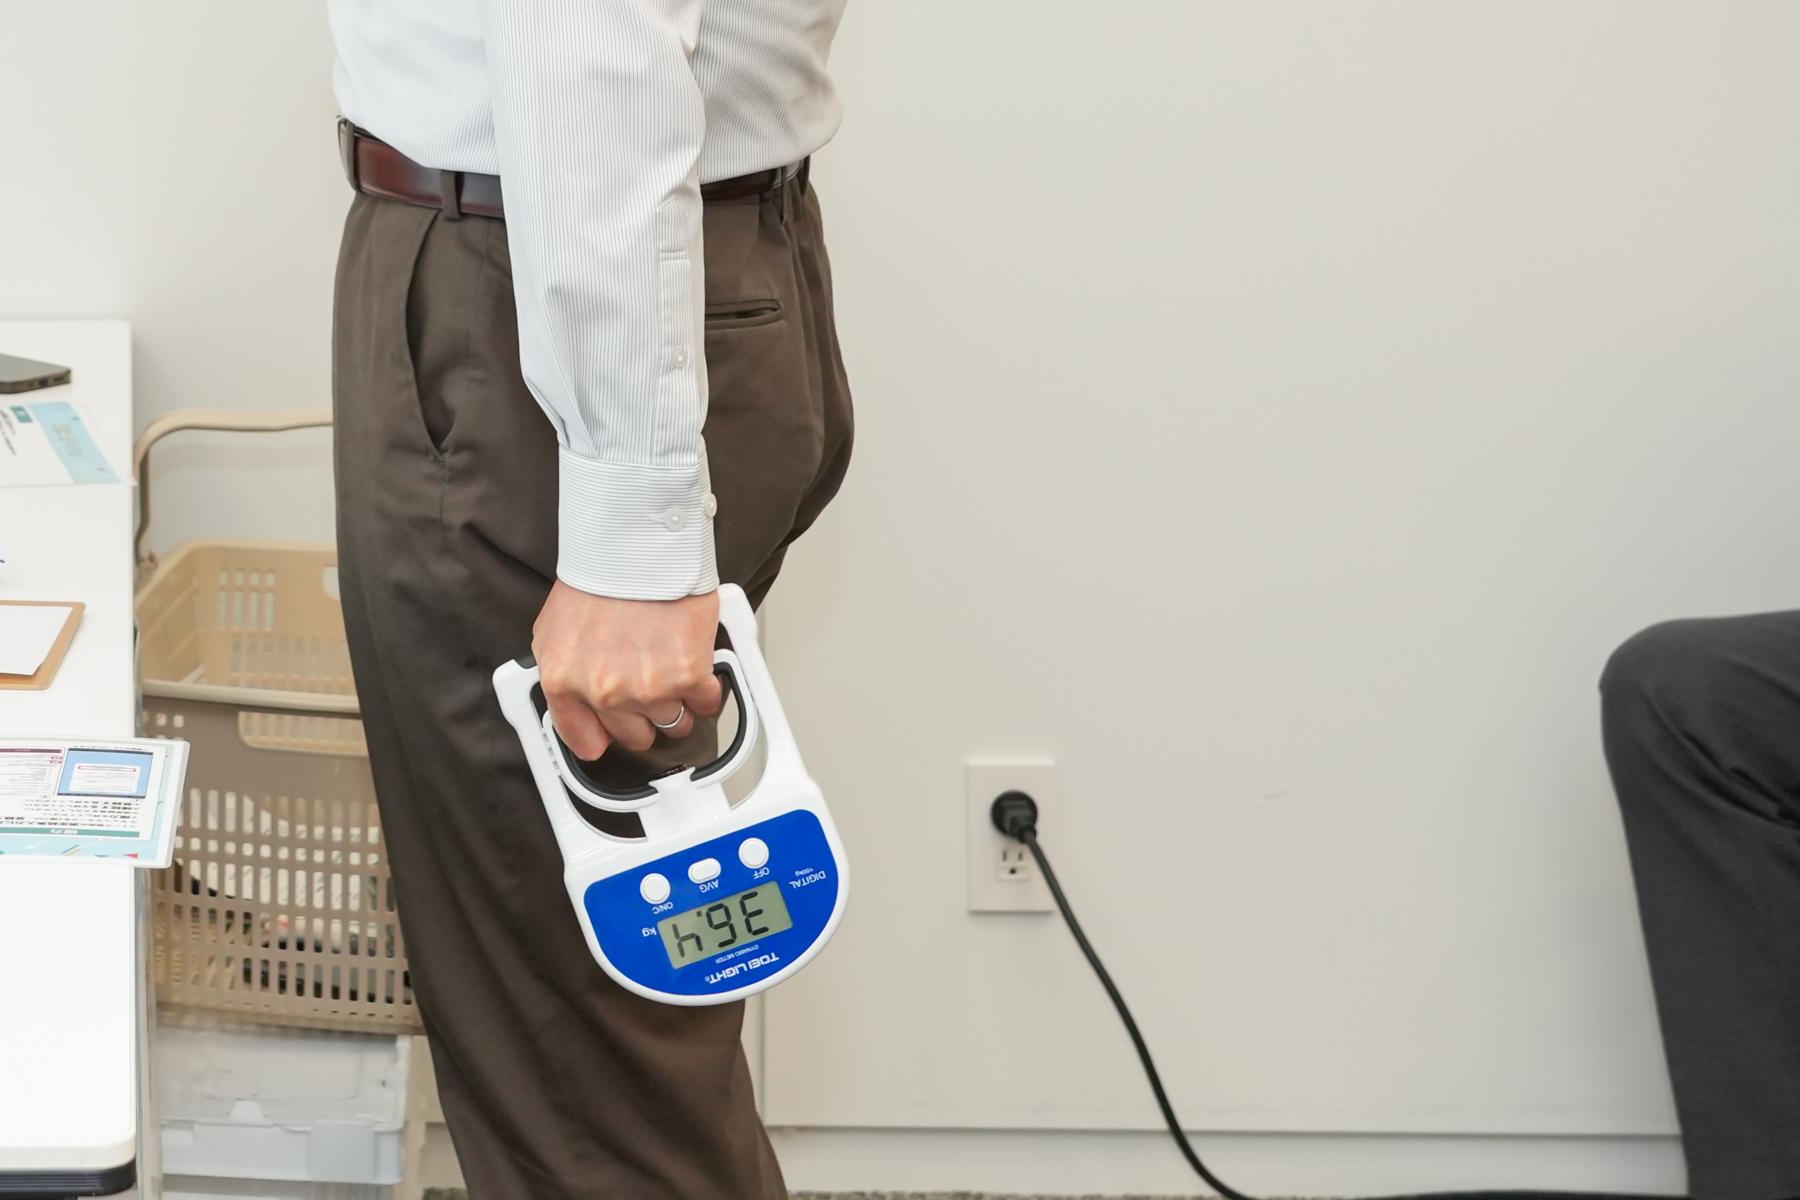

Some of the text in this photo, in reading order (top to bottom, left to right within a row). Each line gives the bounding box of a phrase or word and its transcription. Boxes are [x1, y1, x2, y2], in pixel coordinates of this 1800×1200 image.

[753, 866, 770, 879] OFF
[788, 870, 826, 889] DIGITAL
[699, 879, 719, 893] AVG
[652, 901, 674, 915] ON/C
[671, 891, 769, 957] 36.4
[747, 951, 780, 970] TOEI
